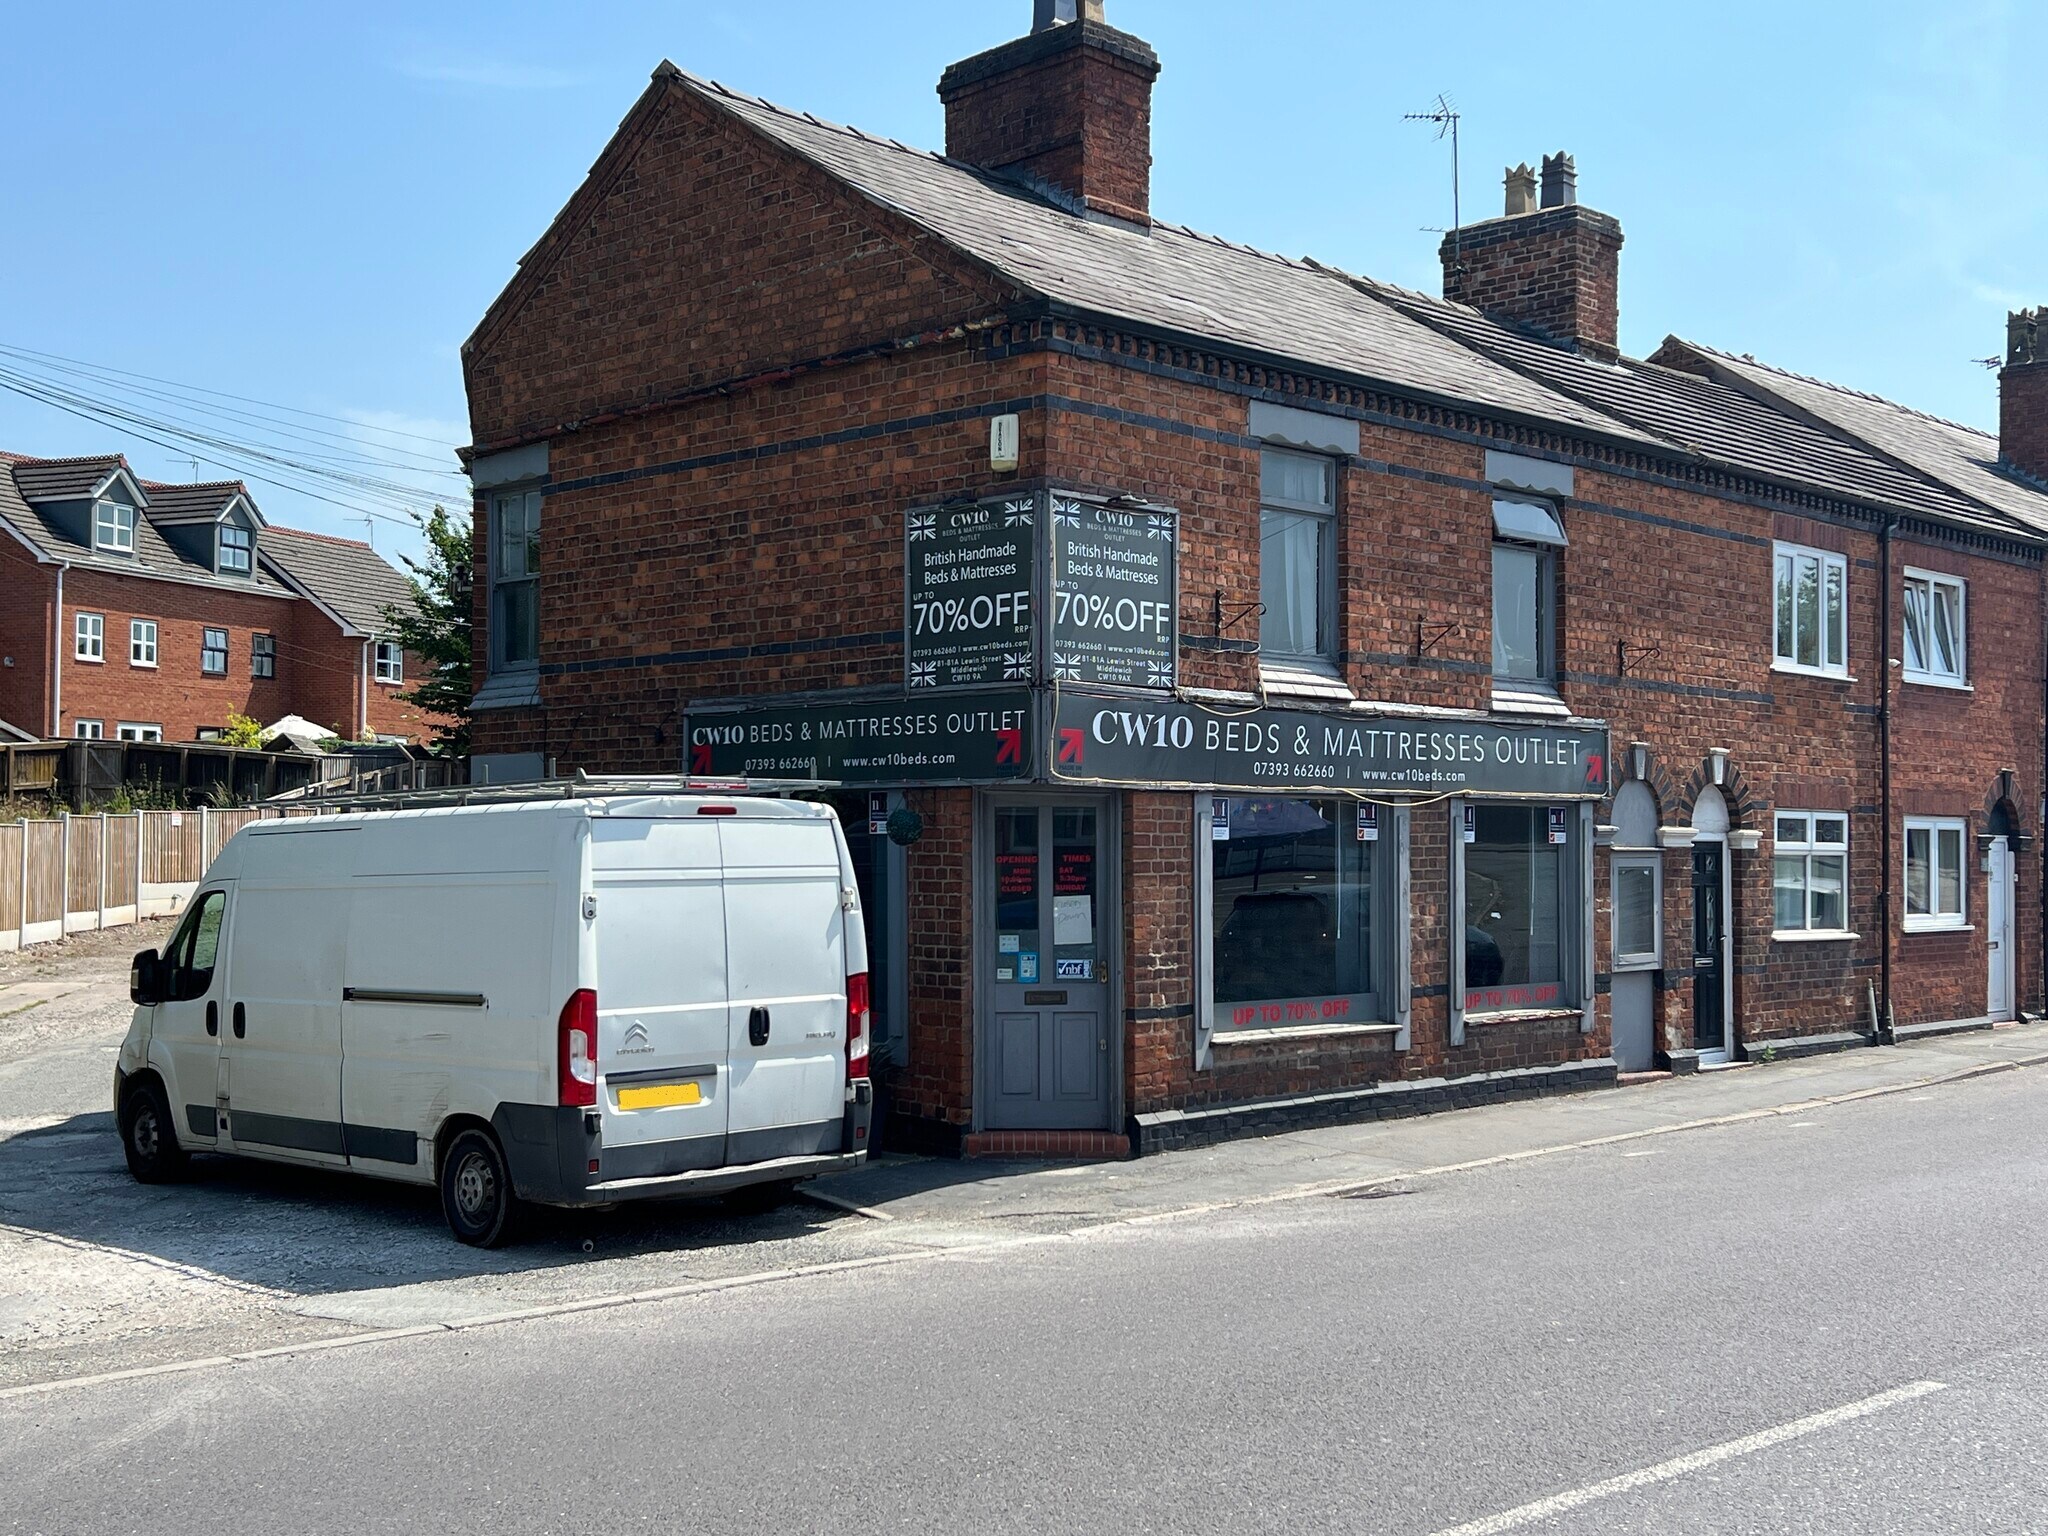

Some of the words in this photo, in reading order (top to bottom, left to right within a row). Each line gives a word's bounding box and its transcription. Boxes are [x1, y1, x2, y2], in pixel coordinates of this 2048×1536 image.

[951, 510, 989, 527] CW10
[1096, 510, 1134, 527] CW10
[942, 528, 956, 537] BEDS
[1087, 522, 1102, 530] BEDS
[1108, 524, 1142, 536] MATTRESSES
[960, 534, 980, 542] OUTLET
[1104, 534, 1125, 542] OUTLET
[924, 550, 956, 566] British
[959, 541, 1016, 562] Handmade
[1068, 541, 1100, 558] British
[1104, 546, 1158, 566] Handmade
[924, 568, 948, 585] Beds
[950, 568, 958, 582] &
[960, 564, 1016, 580] Mattresses
[1068, 560, 1093, 576] Beds
[1096, 564, 1104, 578] &
[1106, 565, 1158, 584] Mattresses
[1068, 581, 1078, 590] TO
[924, 591, 934, 600] TO
[913, 648, 932, 657] 07393
[934, 647, 956, 655] 662660
[962, 640, 1028, 652] www.cw10beds.com
[1055, 640, 1075, 648] 07393
[1078, 642, 1102, 651] 662660
[1108, 646, 1170, 657] www.cw10beds.com
[982, 655, 1002, 663] Street
[1127, 659, 1146, 667] Street
[951, 664, 987, 674] Middlewich
[1096, 664, 1132, 674] Middlewich
[692, 725, 744, 746] CW10
[750, 723, 793, 743] BEDS
[800, 722, 812, 741] &
[819, 714, 938, 740] MATTRESSES
[946, 710, 1026, 733] OUTLET
[1092, 710, 1194, 748] CW10
[1206, 720, 1280, 754] BEDS
[1294, 725, 1310, 756] &
[1324, 727, 1485, 762] MATTRESSES
[1495, 736, 1581, 766] OUTLET
[745, 758, 775, 770] 07393
[779, 757, 817, 769] 662660
[843, 752, 956, 768] www.cw10beds.com
[1253, 761, 1289, 776] 07393
[1294, 763, 1335, 778] 662660
[1362, 768, 1466, 782] www.cw10beds.com
[1066, 964, 1082, 975] nbf
[1466, 992, 1482, 1009] UP
[1485, 991, 1502, 1006] TO
[1535, 986, 1558, 1002] OFF
[1233, 1007, 1255, 1025] UP
[1260, 1004, 1281, 1022] TO
[1286, 1002, 1318, 1020] 70%
[1322, 999, 1350, 1017] OFF
